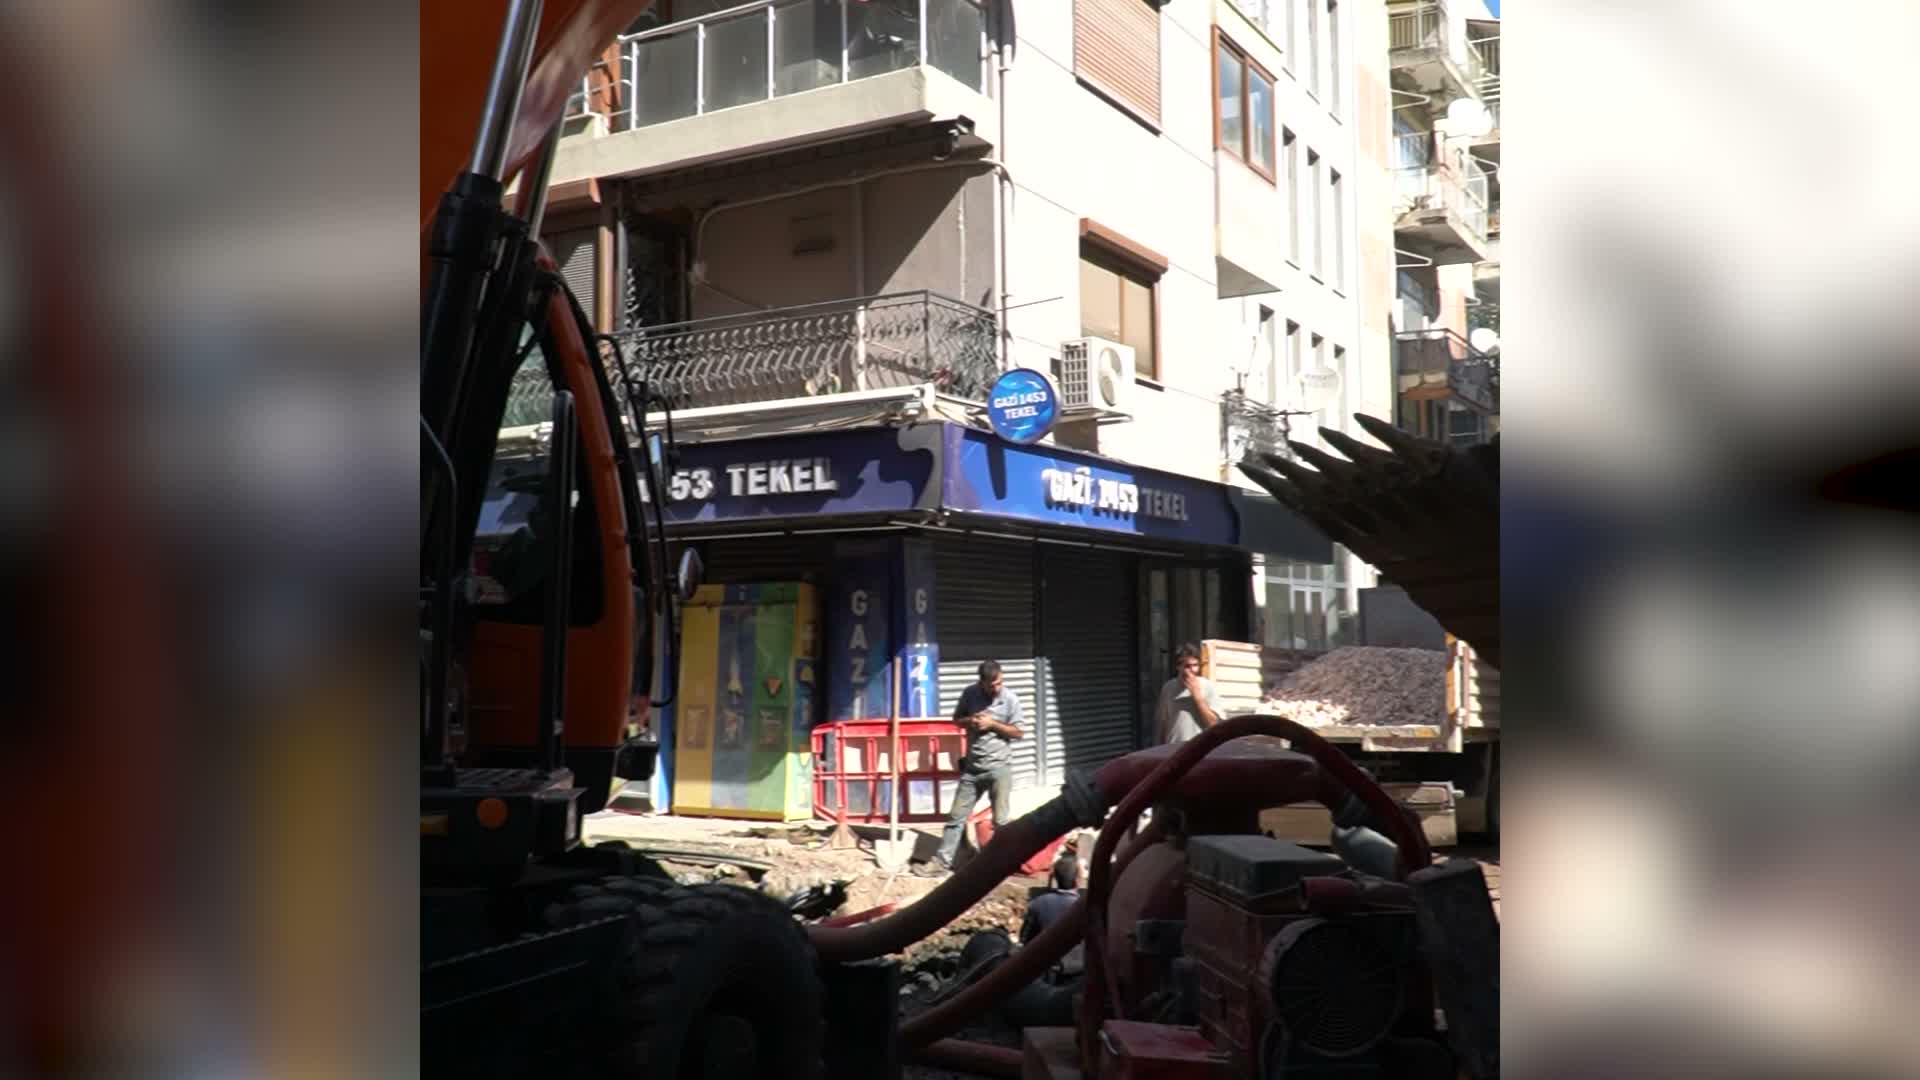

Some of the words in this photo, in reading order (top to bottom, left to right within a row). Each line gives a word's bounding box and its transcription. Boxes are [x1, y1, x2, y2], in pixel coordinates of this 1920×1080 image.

[1019, 391, 1047, 405] 1453
[1004, 405, 1039, 419] TEKEL
[725, 459, 838, 496] TEKEL
[1097, 478, 1139, 513] 1453
[1141, 487, 1189, 521] TEKEL
